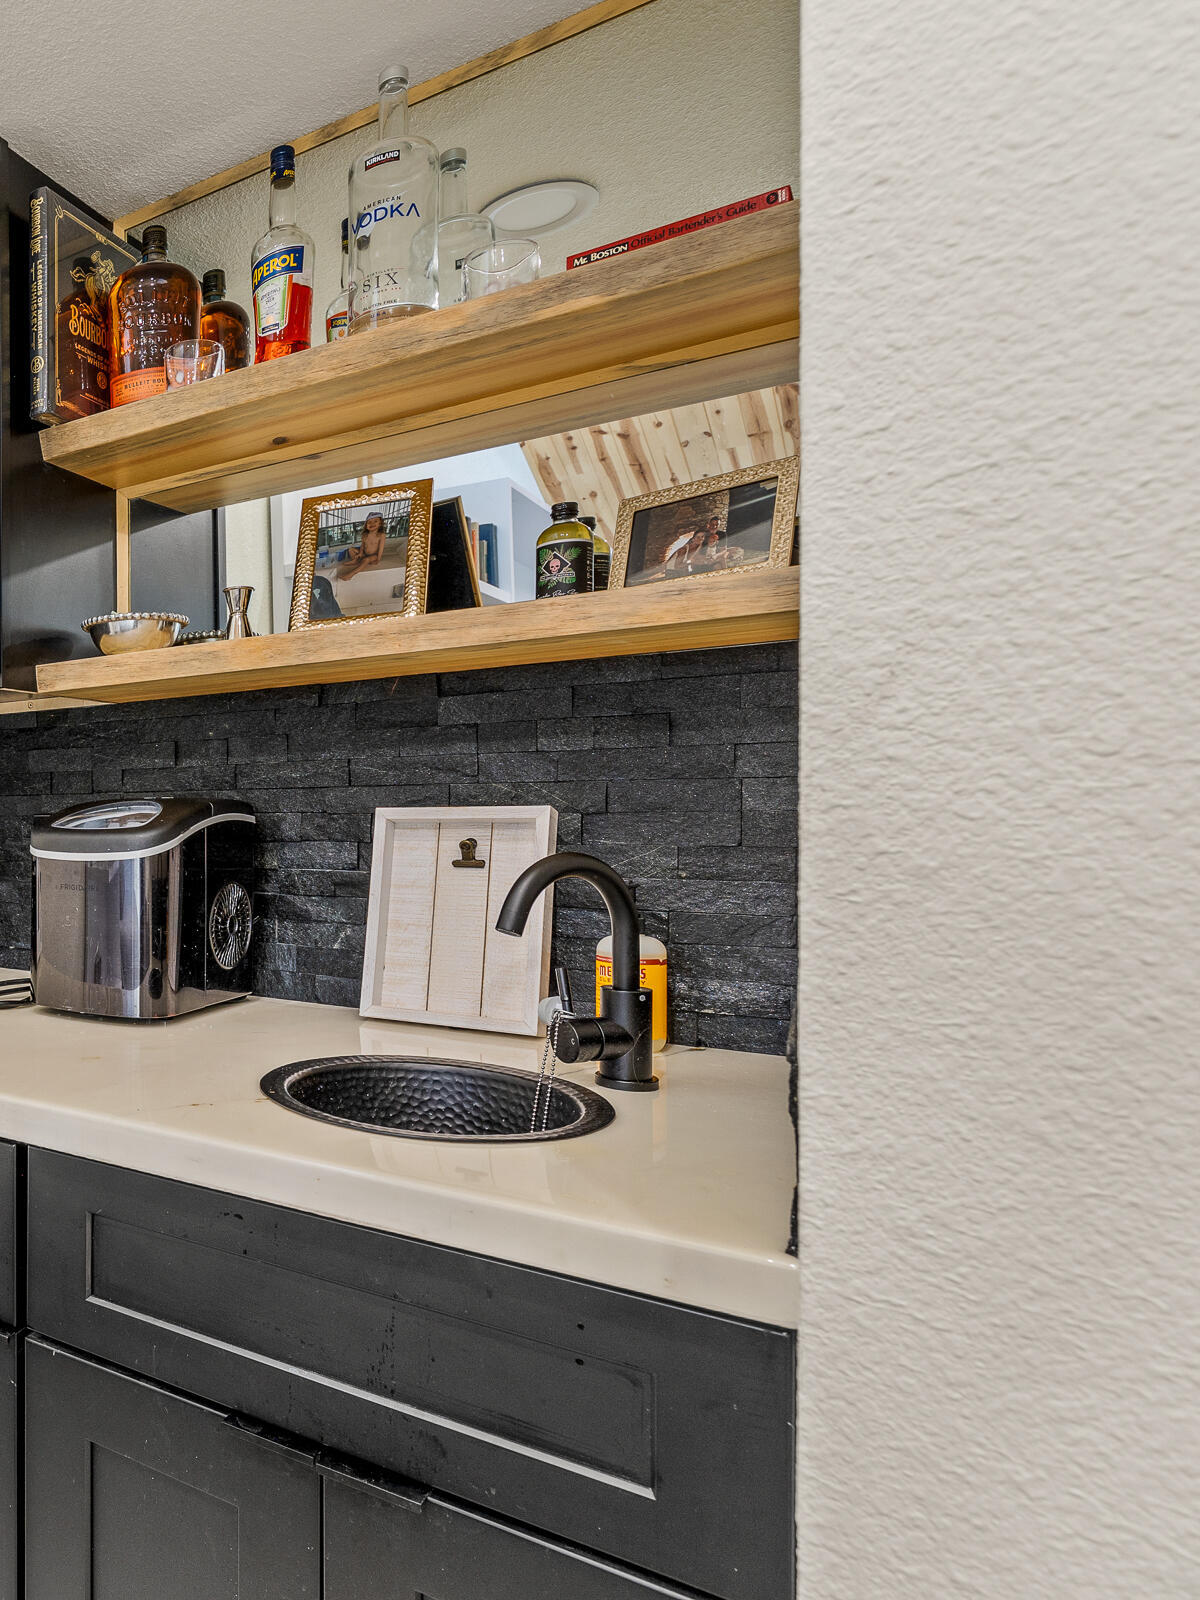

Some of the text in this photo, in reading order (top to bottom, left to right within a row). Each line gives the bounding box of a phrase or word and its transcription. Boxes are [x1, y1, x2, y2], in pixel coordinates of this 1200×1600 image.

[366, 150, 400, 167] KIRKLAND
[30, 196, 44, 237] BOURBON
[351, 203, 421, 234] VODKA
[363, 195, 402, 211] AMERICAN
[630, 229, 666, 249] Official
[667, 211, 723, 236] Bartender's
[726, 200, 757, 218] Guide
[253, 254, 298, 289] APEROL
[362, 271, 399, 293] SIX
[69, 304, 107, 348] BOURBO
